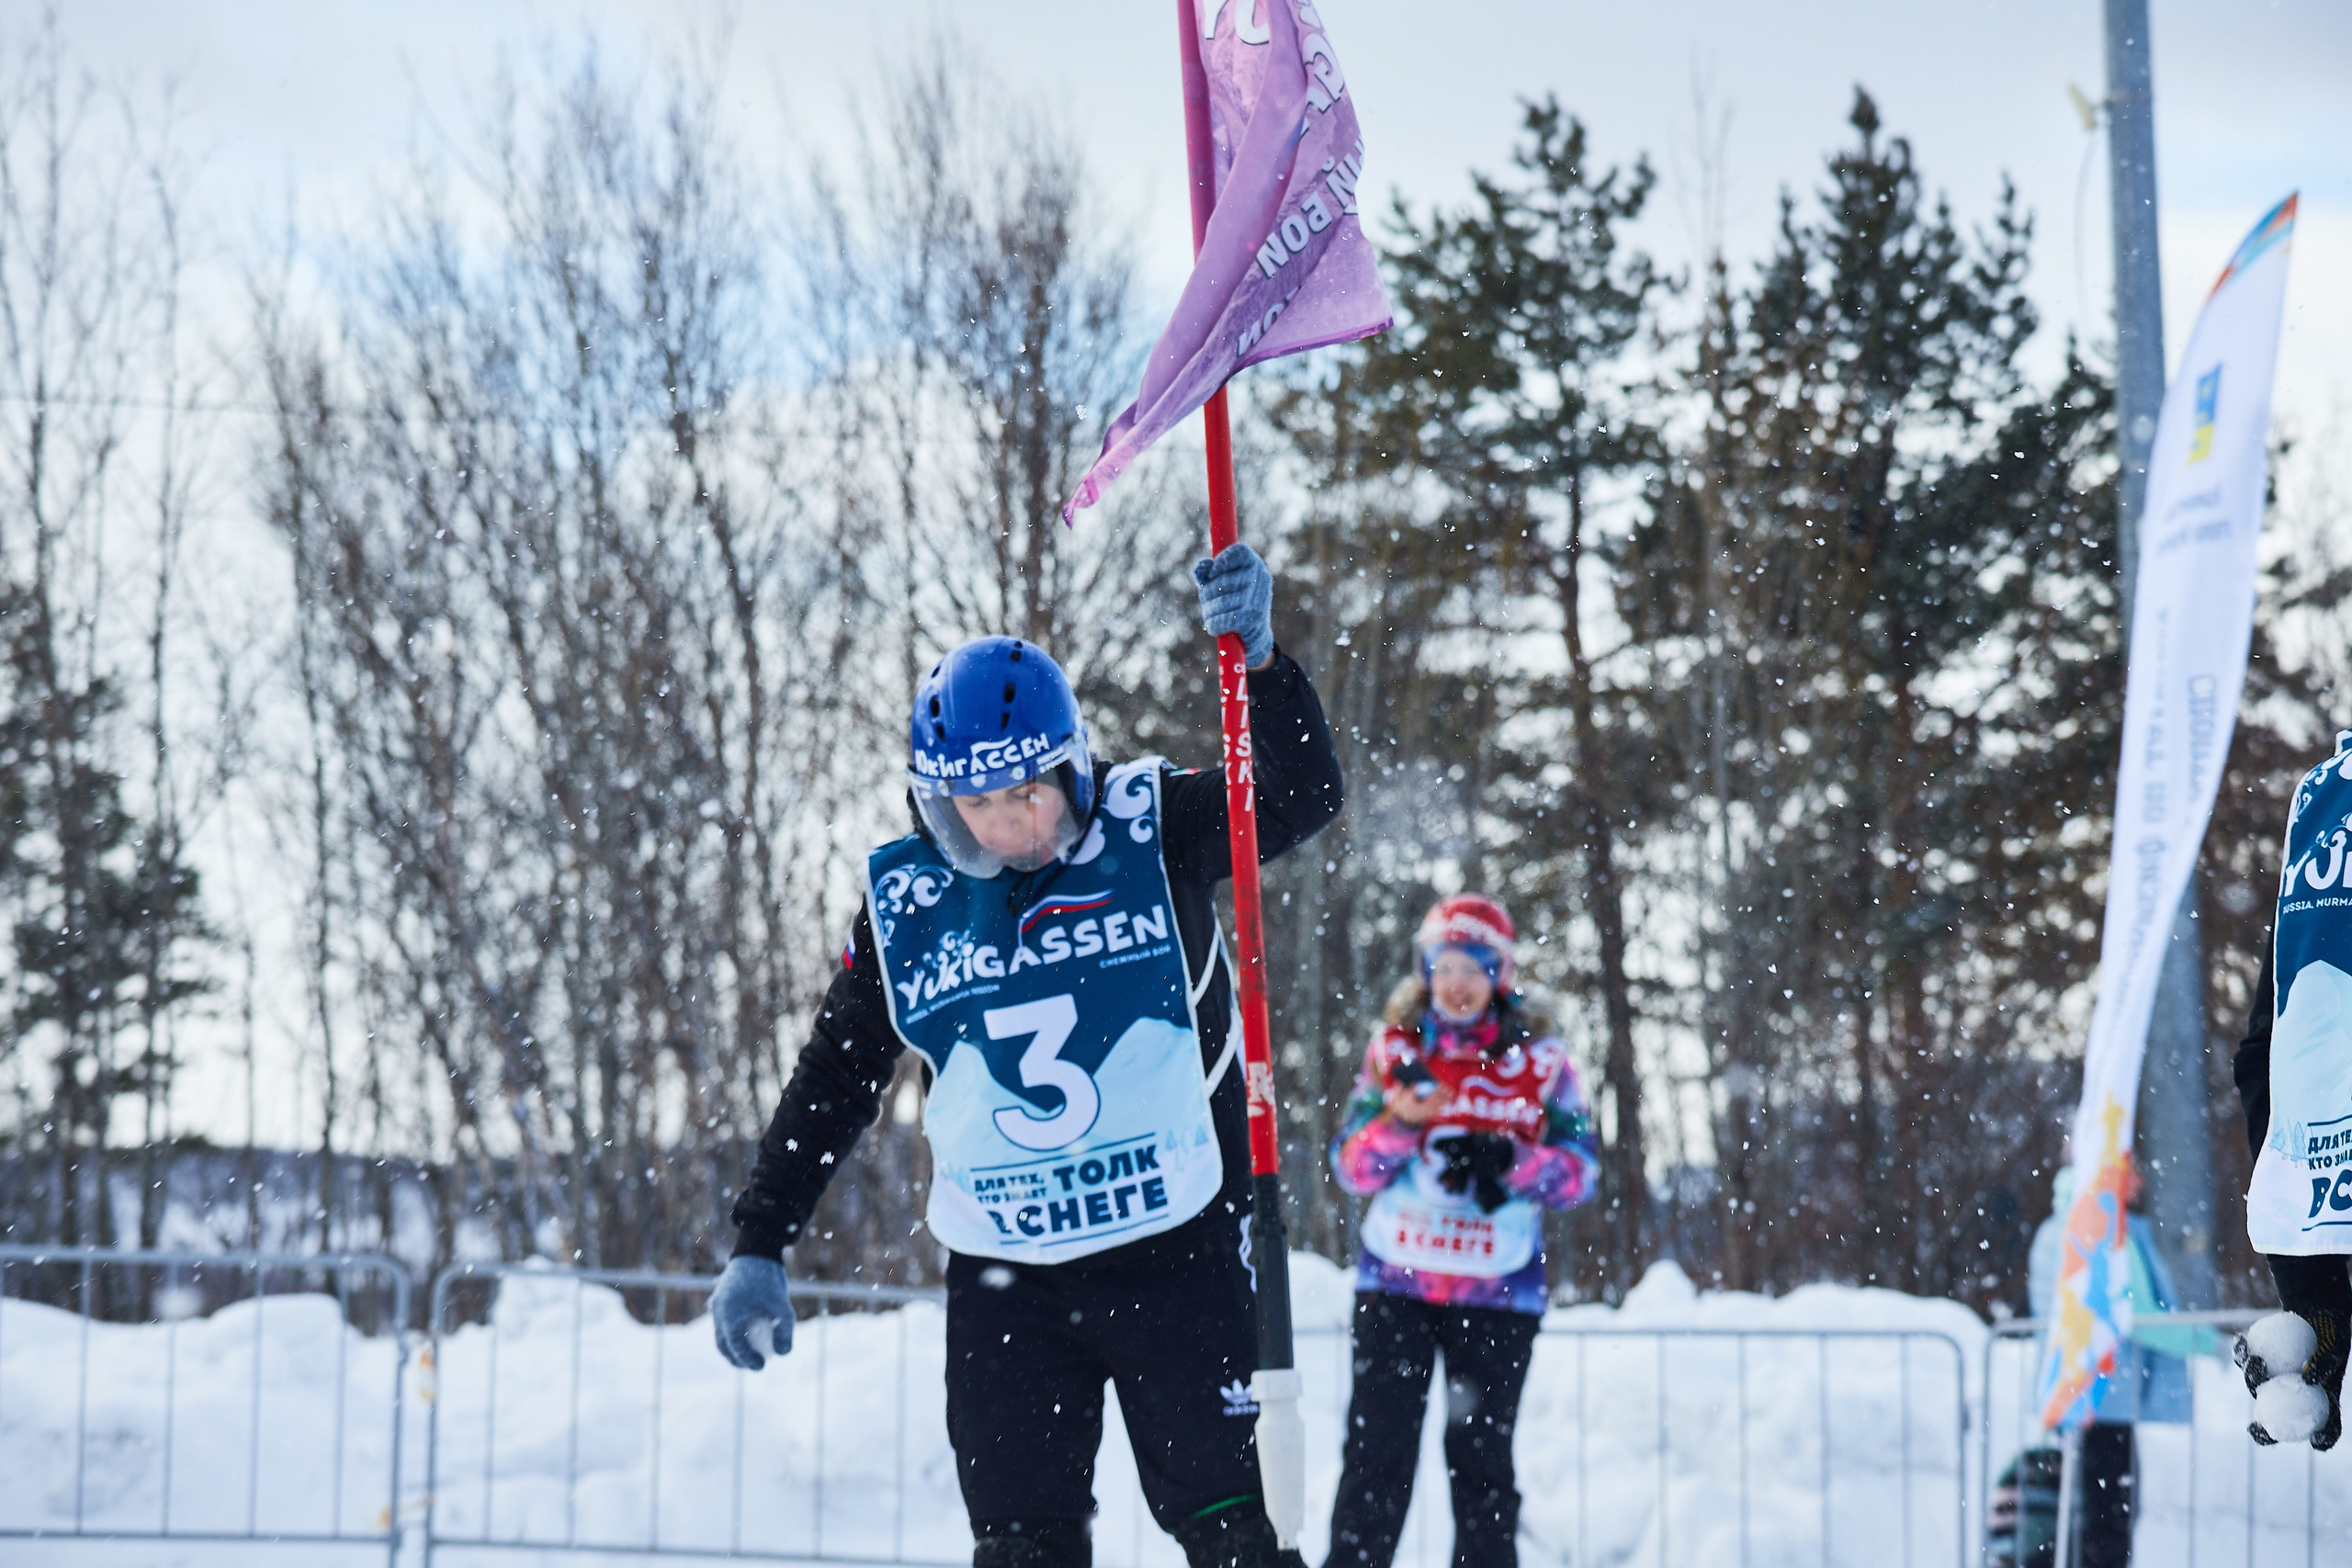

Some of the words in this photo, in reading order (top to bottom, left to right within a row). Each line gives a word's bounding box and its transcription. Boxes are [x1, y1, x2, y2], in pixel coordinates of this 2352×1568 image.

[983, 993, 1102, 1153] 3
[1053, 1145, 1160, 1192] ТОЛК
[2308, 1155, 2333, 1170] КТО
[1016, 1176, 1169, 1236] СНЕГЕ
